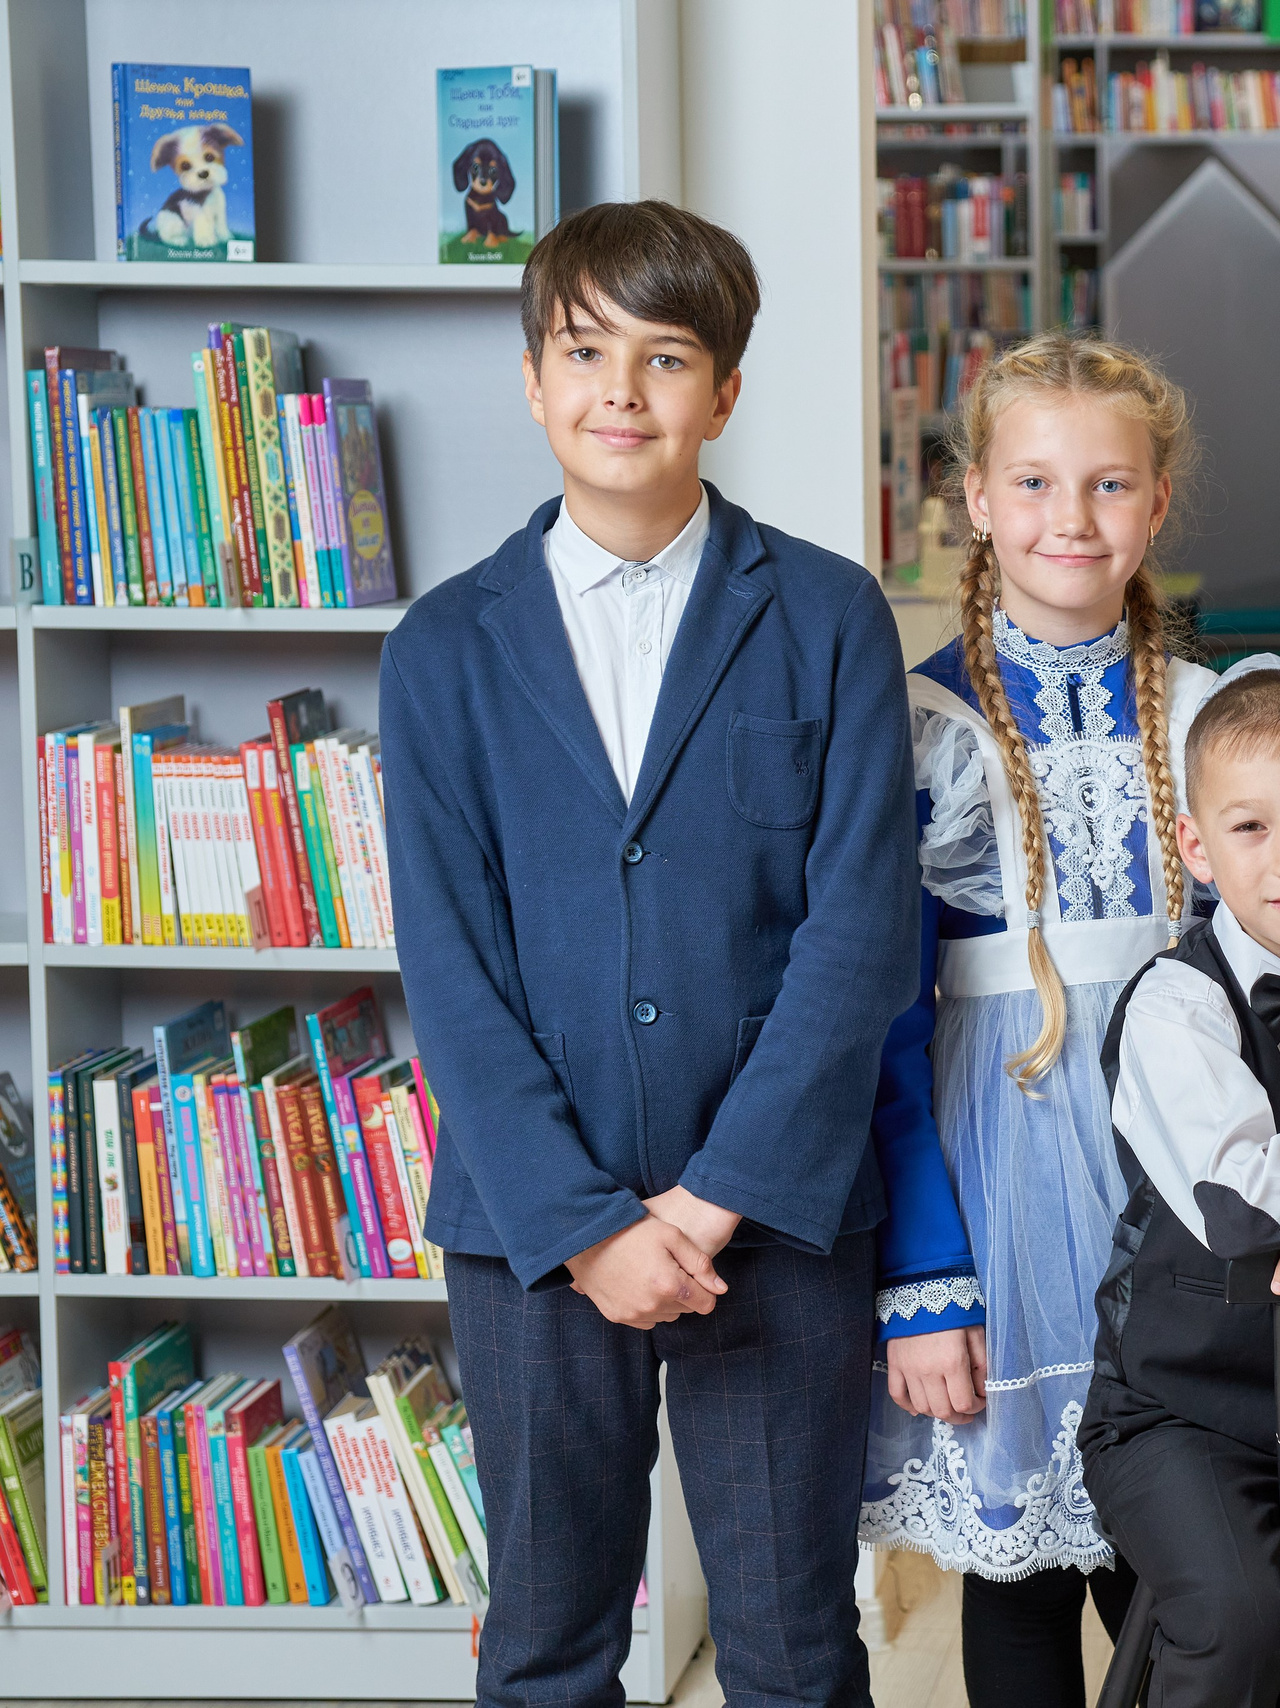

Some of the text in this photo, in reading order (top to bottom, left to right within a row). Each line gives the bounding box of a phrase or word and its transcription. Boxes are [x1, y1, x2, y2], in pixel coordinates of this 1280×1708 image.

[134, 77, 249, 98] Щенок Крошка,
[175, 97, 194, 107] или
[139, 104, 185, 120] Друзья
[91, 1460, 111, 1556] ДЖЕК СТАЛВО
